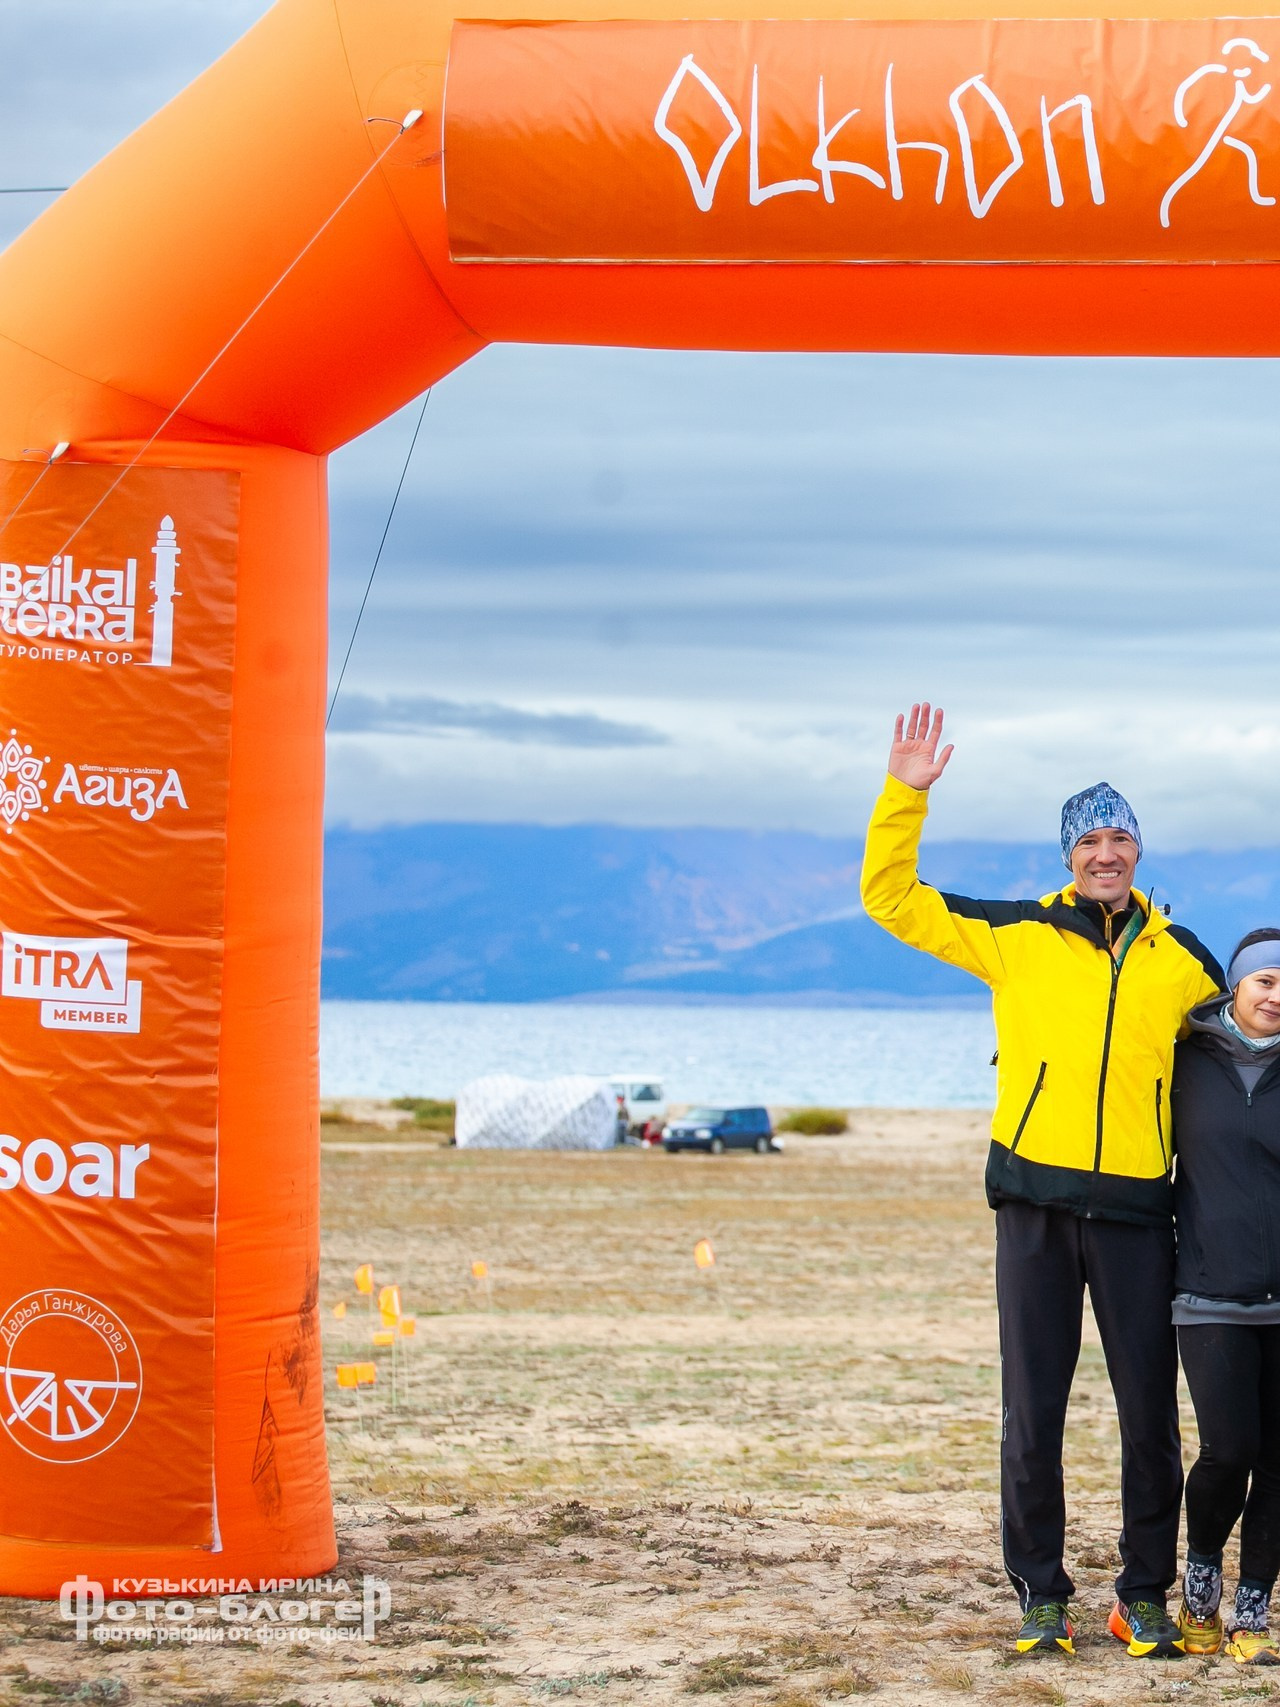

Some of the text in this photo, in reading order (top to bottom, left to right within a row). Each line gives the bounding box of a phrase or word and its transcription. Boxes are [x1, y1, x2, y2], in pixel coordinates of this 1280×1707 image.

[53, 1009, 129, 1025] MEMBER
[1, 1294, 128, 1352] Дарья Ганжурова
